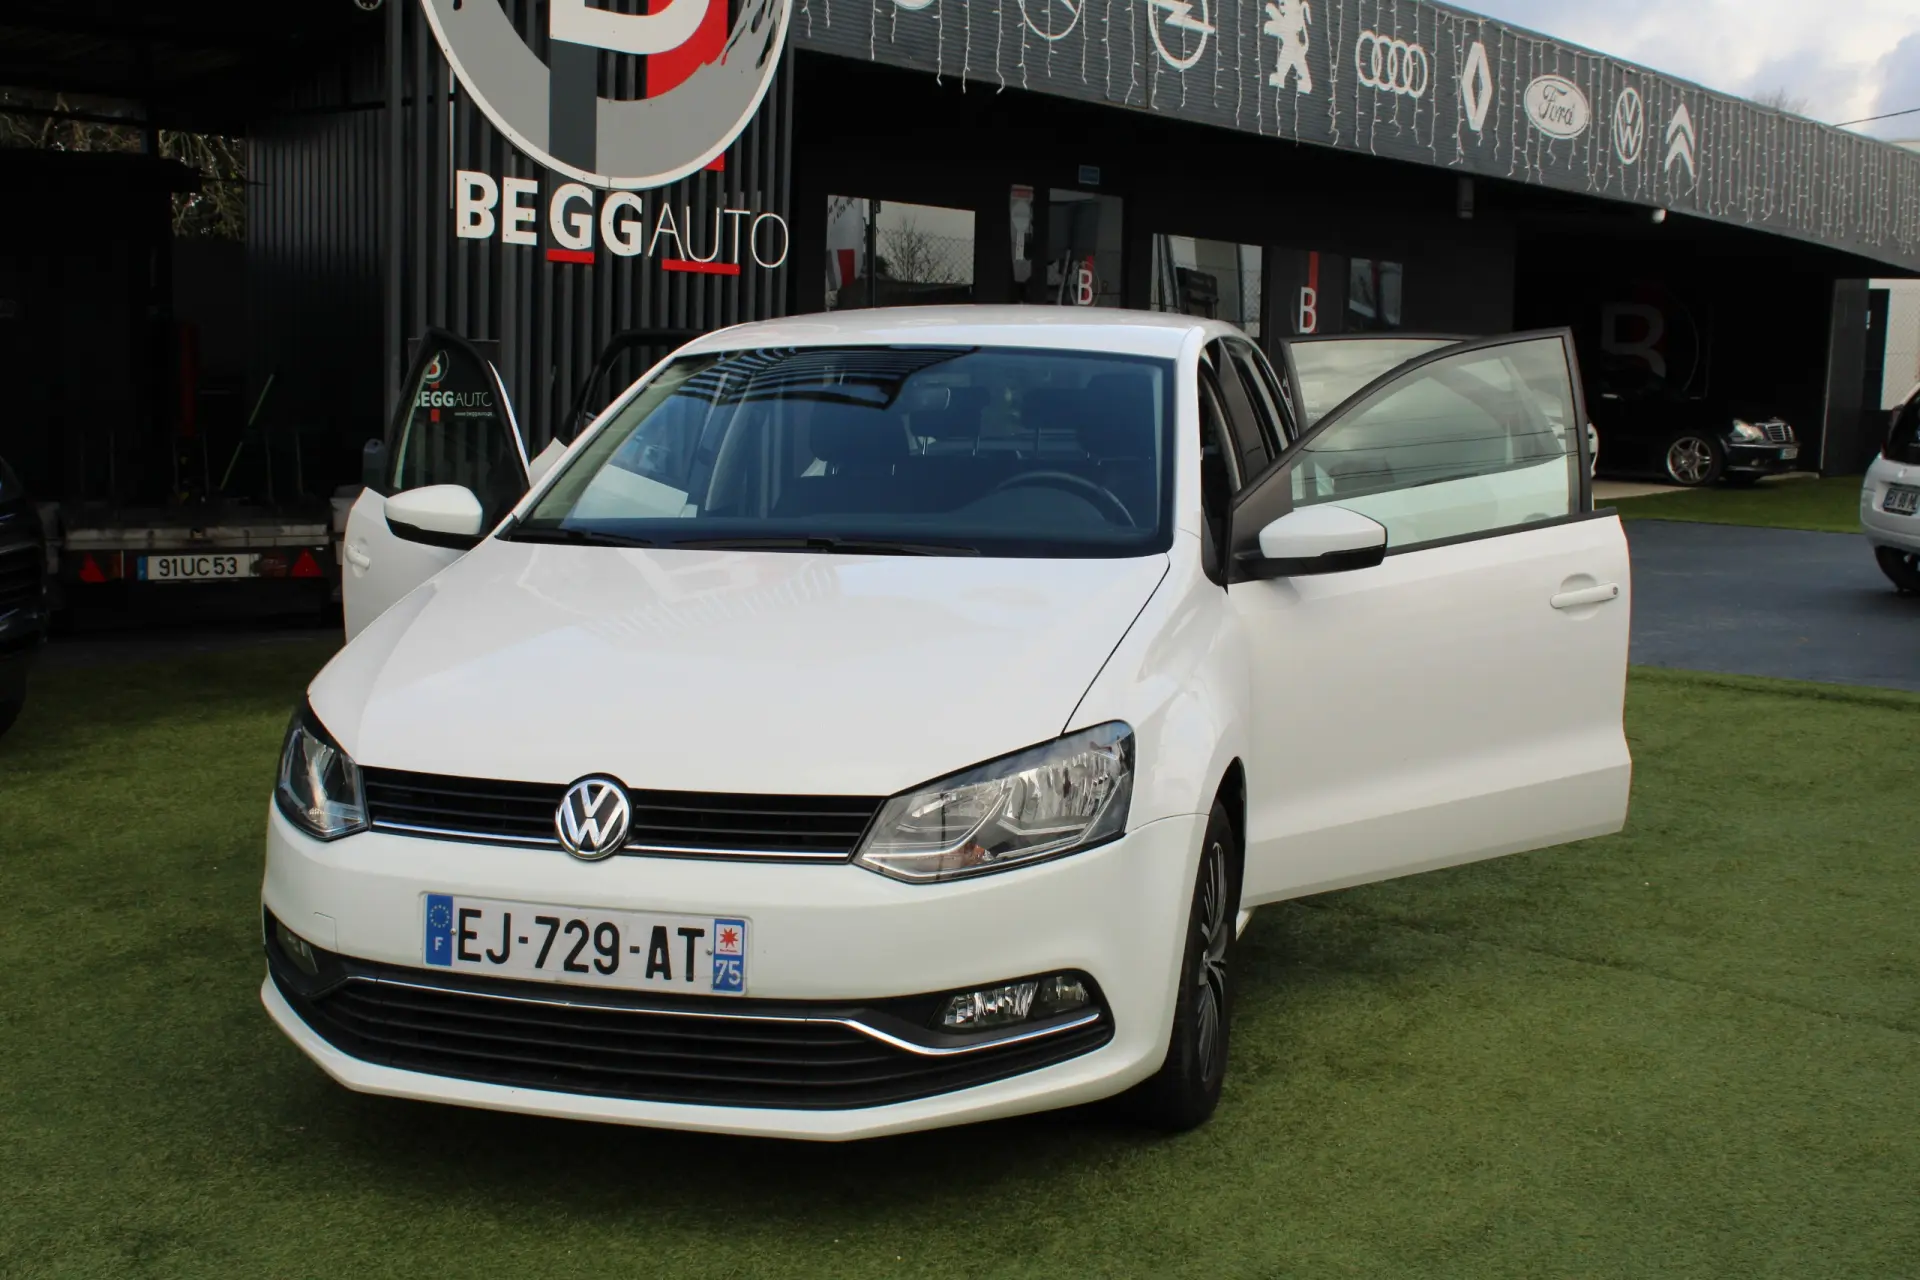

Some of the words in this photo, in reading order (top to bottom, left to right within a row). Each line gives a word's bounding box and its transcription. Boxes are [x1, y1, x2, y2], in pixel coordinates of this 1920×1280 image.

[1538, 84, 1576, 126] Ford
[1077, 268, 1093, 305] B
[1299, 286, 1317, 334] B
[434, 936, 444, 951] F
[457, 907, 705, 983] EJ-729-AT
[715, 959, 741, 986] 75
